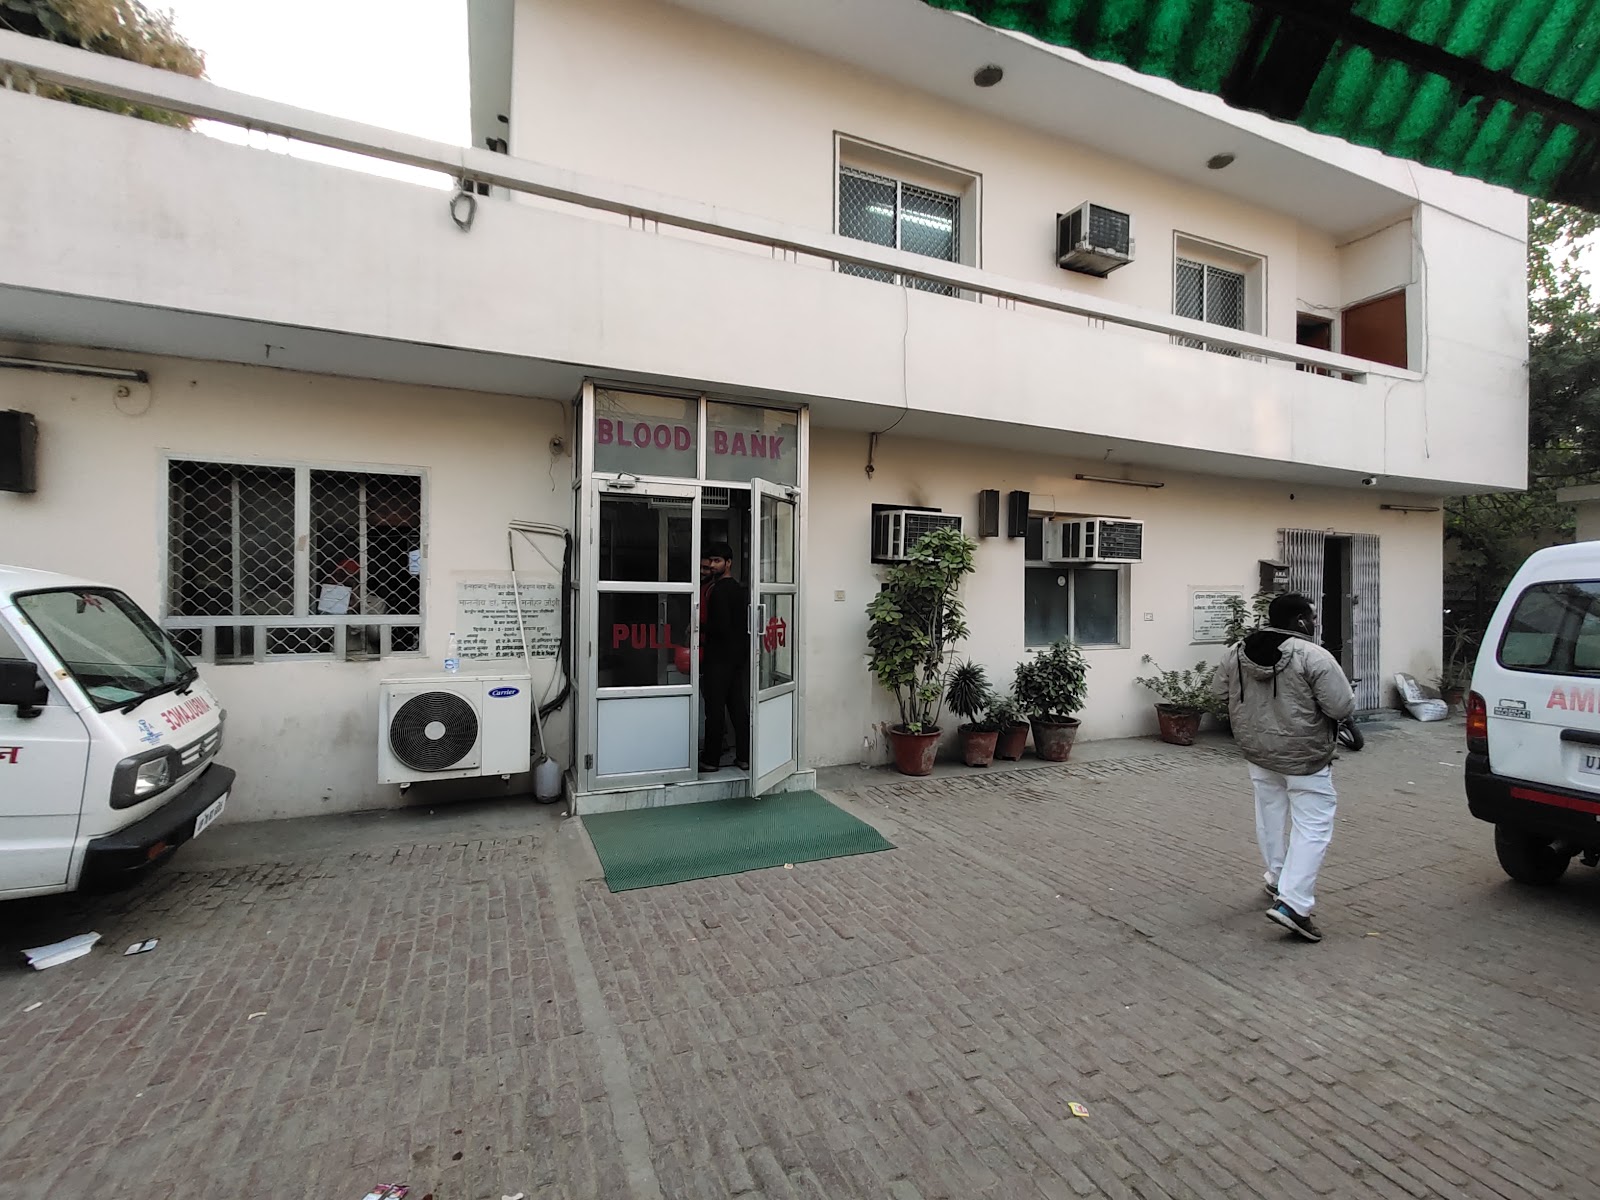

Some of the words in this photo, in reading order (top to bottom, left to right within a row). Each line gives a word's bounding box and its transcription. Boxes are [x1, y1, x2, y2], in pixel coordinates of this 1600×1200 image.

[597, 418, 691, 451] BLOOD
[714, 430, 785, 460] BANK
[612, 623, 675, 649] PULL
[491, 688, 516, 697] Carrier
[1546, 685, 1600, 714] AM
